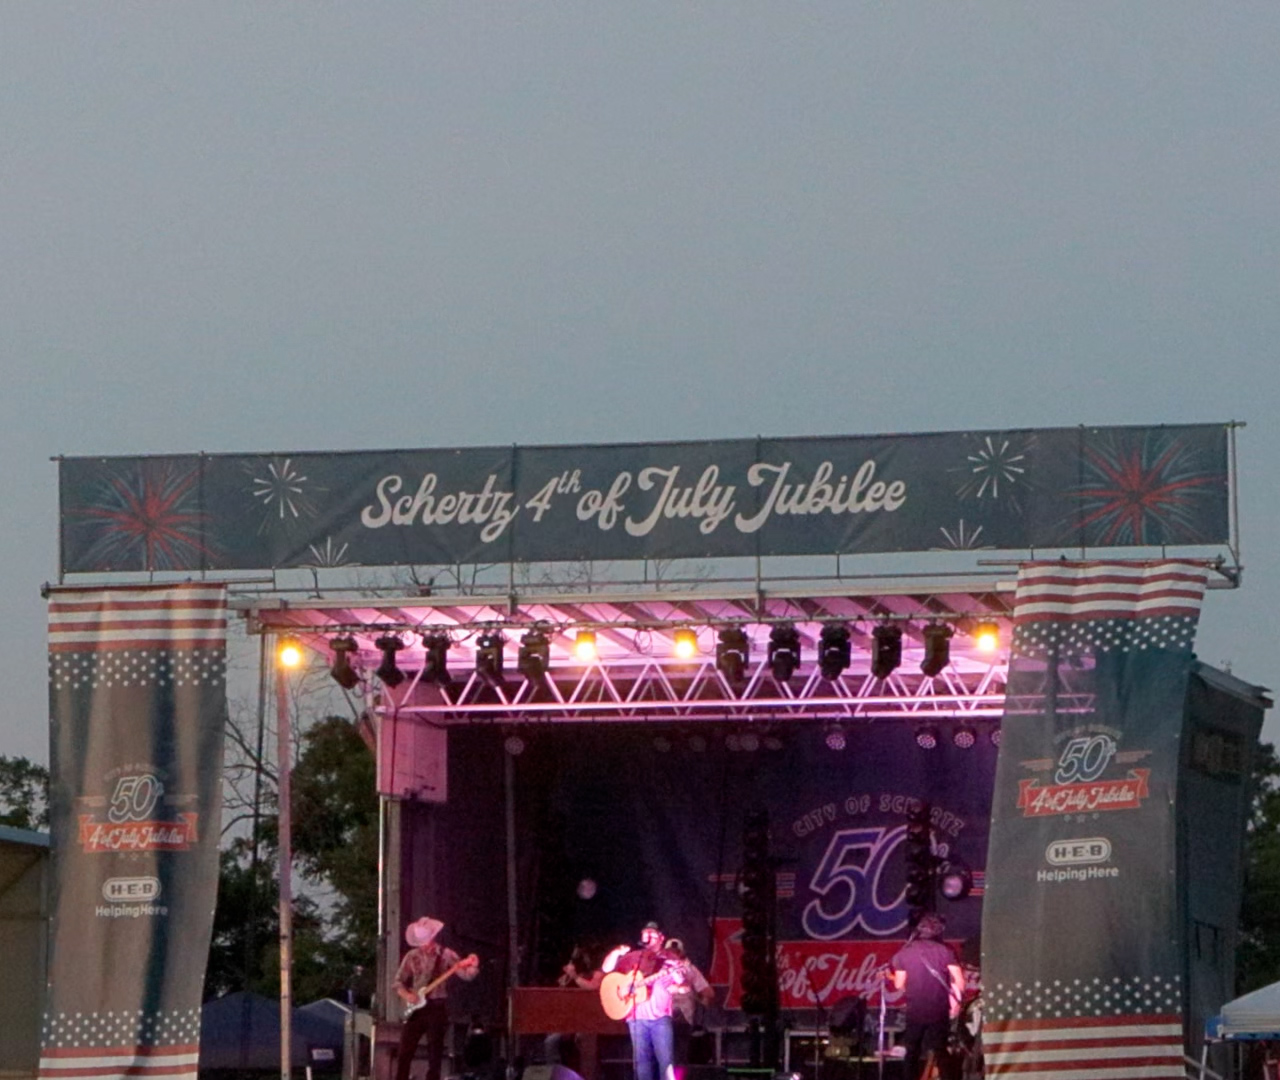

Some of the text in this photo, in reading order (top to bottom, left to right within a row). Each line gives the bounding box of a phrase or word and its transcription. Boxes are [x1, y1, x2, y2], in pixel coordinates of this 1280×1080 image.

[361, 459, 907, 543] Schertz 4th of July Jubilee
[792, 794, 965, 838] CITY OF SCRTZ
[779, 955, 817, 999] of
